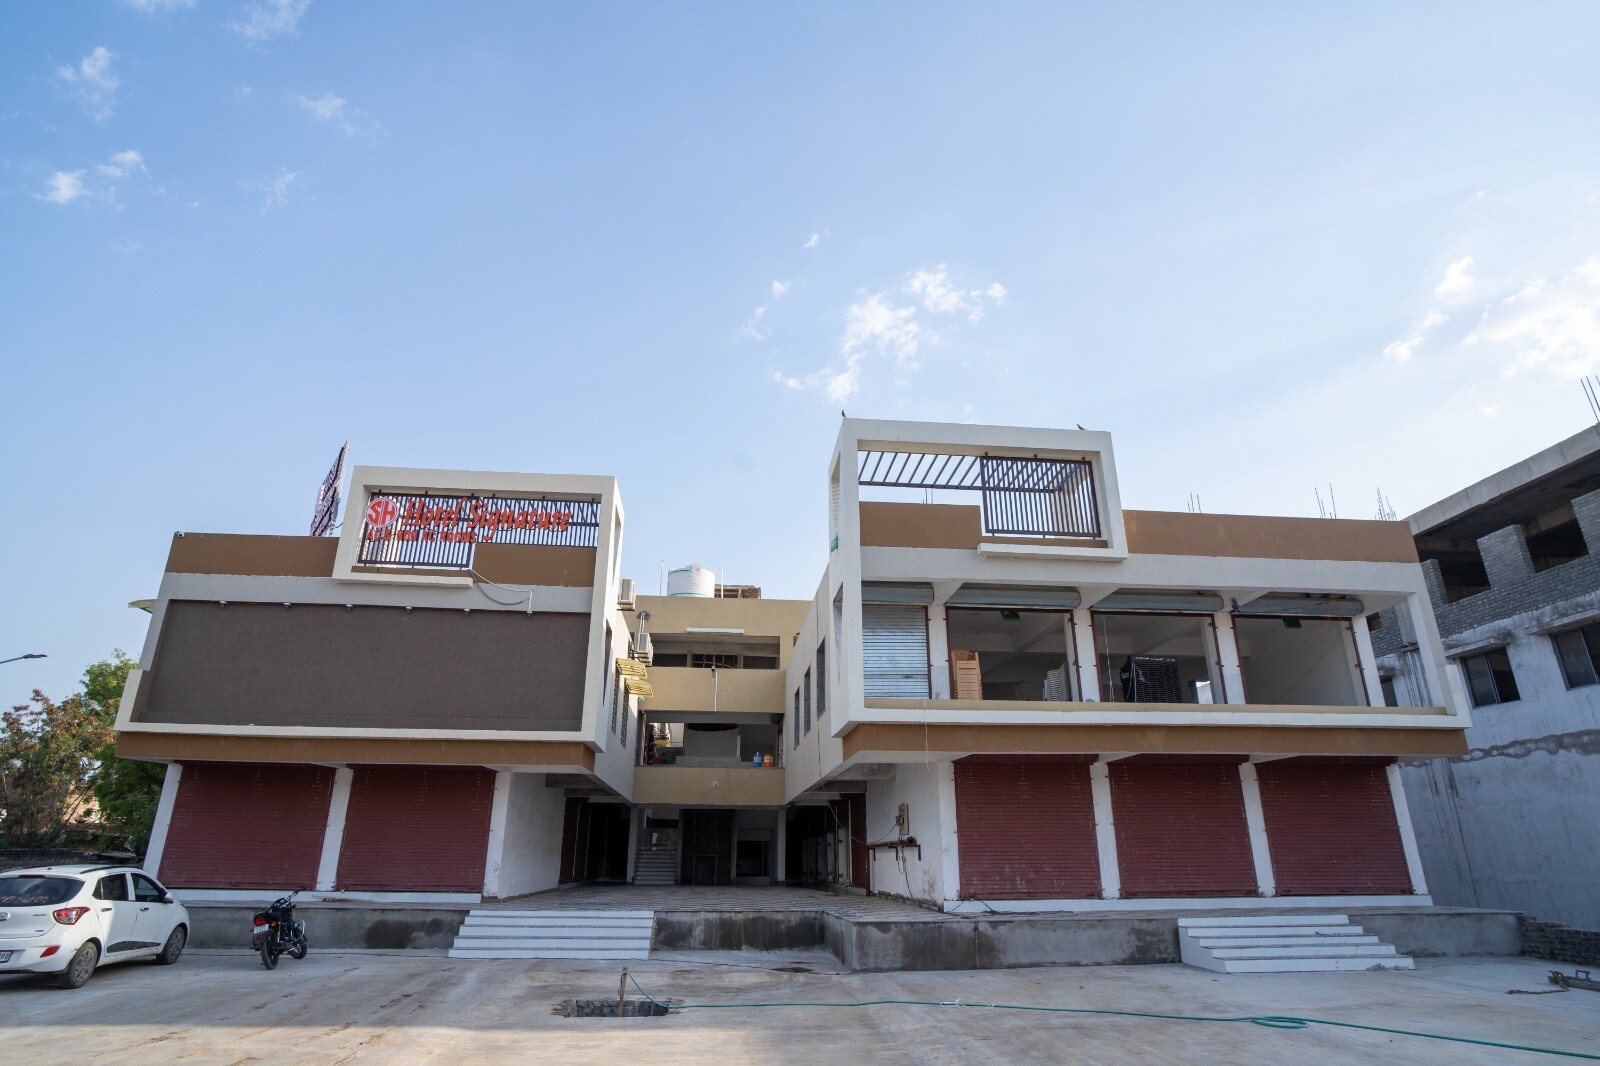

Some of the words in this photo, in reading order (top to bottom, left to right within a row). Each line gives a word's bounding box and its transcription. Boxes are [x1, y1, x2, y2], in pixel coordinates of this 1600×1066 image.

[366, 499, 396, 526] SH
[402, 497, 467, 527] Hotel
[466, 501, 572, 541] Signature
[397, 530, 418, 541] NON
[421, 530, 435, 542] AC
[440, 531, 477, 543] ROOMS
